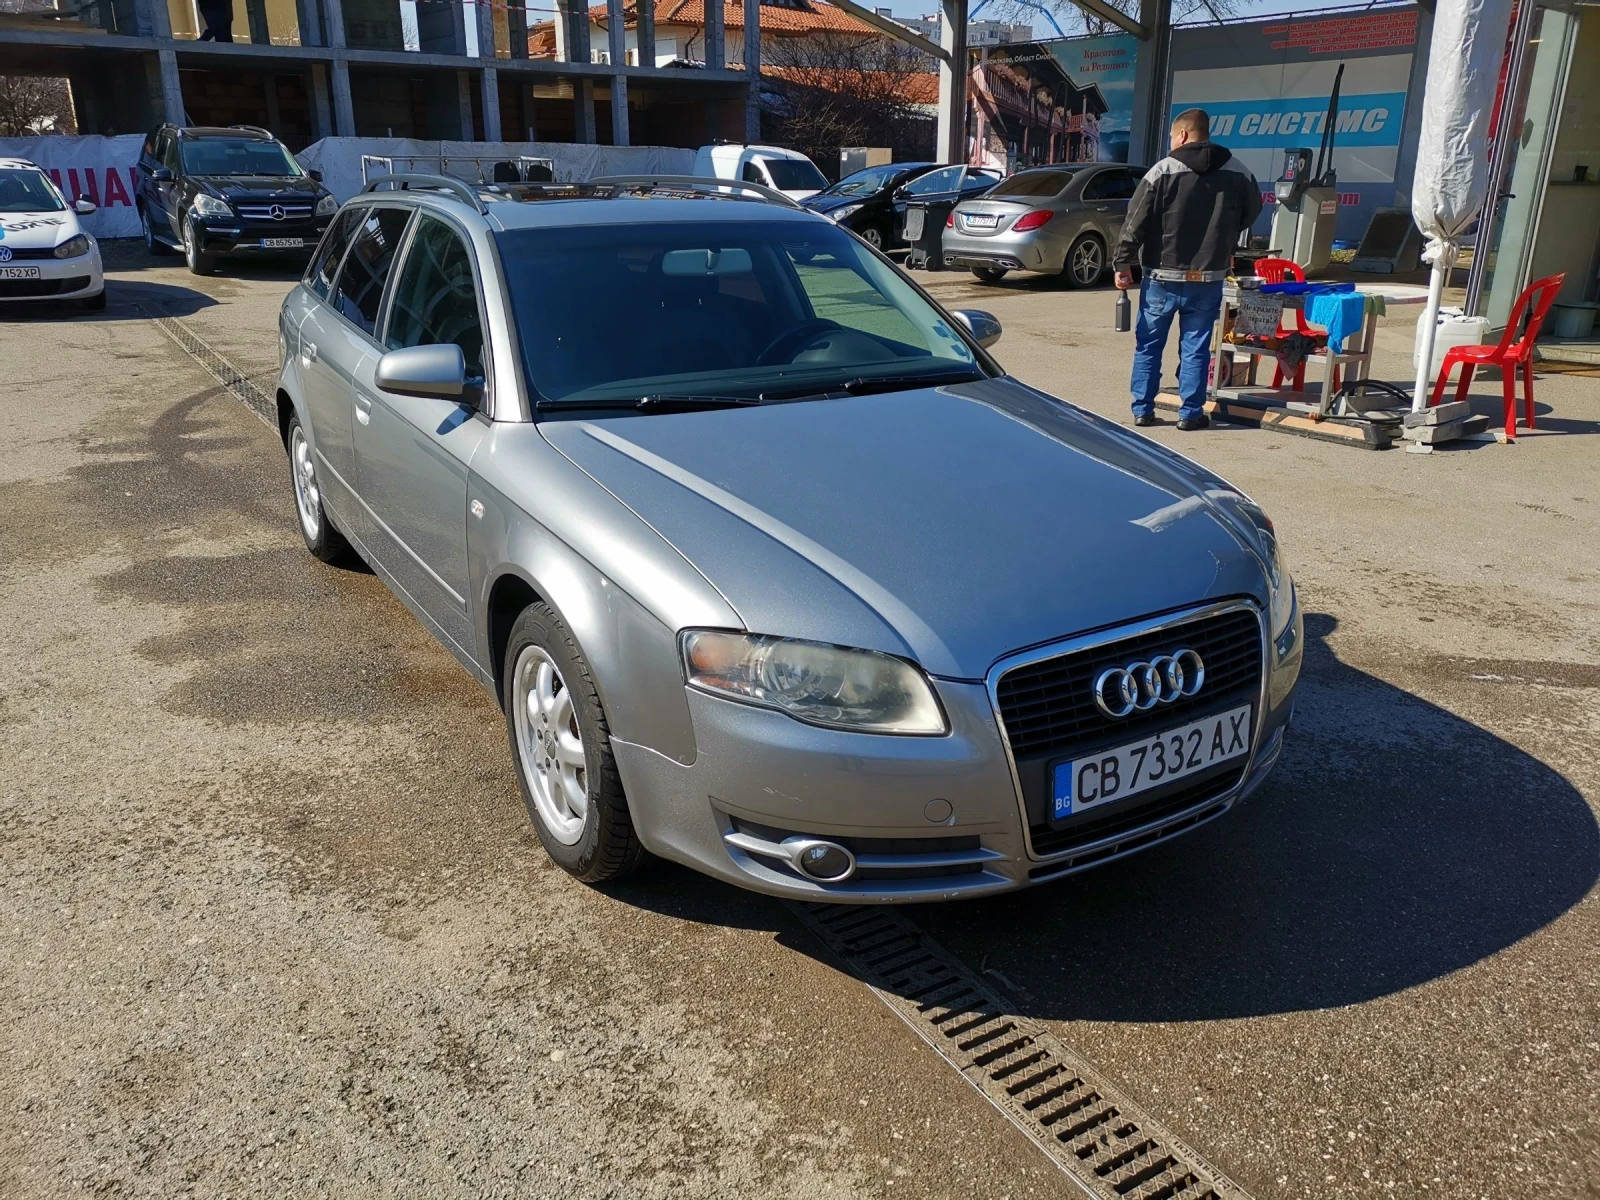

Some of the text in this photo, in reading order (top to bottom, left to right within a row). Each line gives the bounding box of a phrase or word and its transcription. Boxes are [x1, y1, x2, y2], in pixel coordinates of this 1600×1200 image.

[1014, 54, 1035, 62] Област
[1080, 61, 1130, 72] на Родопите
[265, 238, 302, 247] CB 8575 KH
[23, 268, 37, 278] XP
[1243, 303, 1252, 311] Не
[1077, 711, 1246, 804] CB 7332 AX
[1055, 795, 1070, 811] BG
